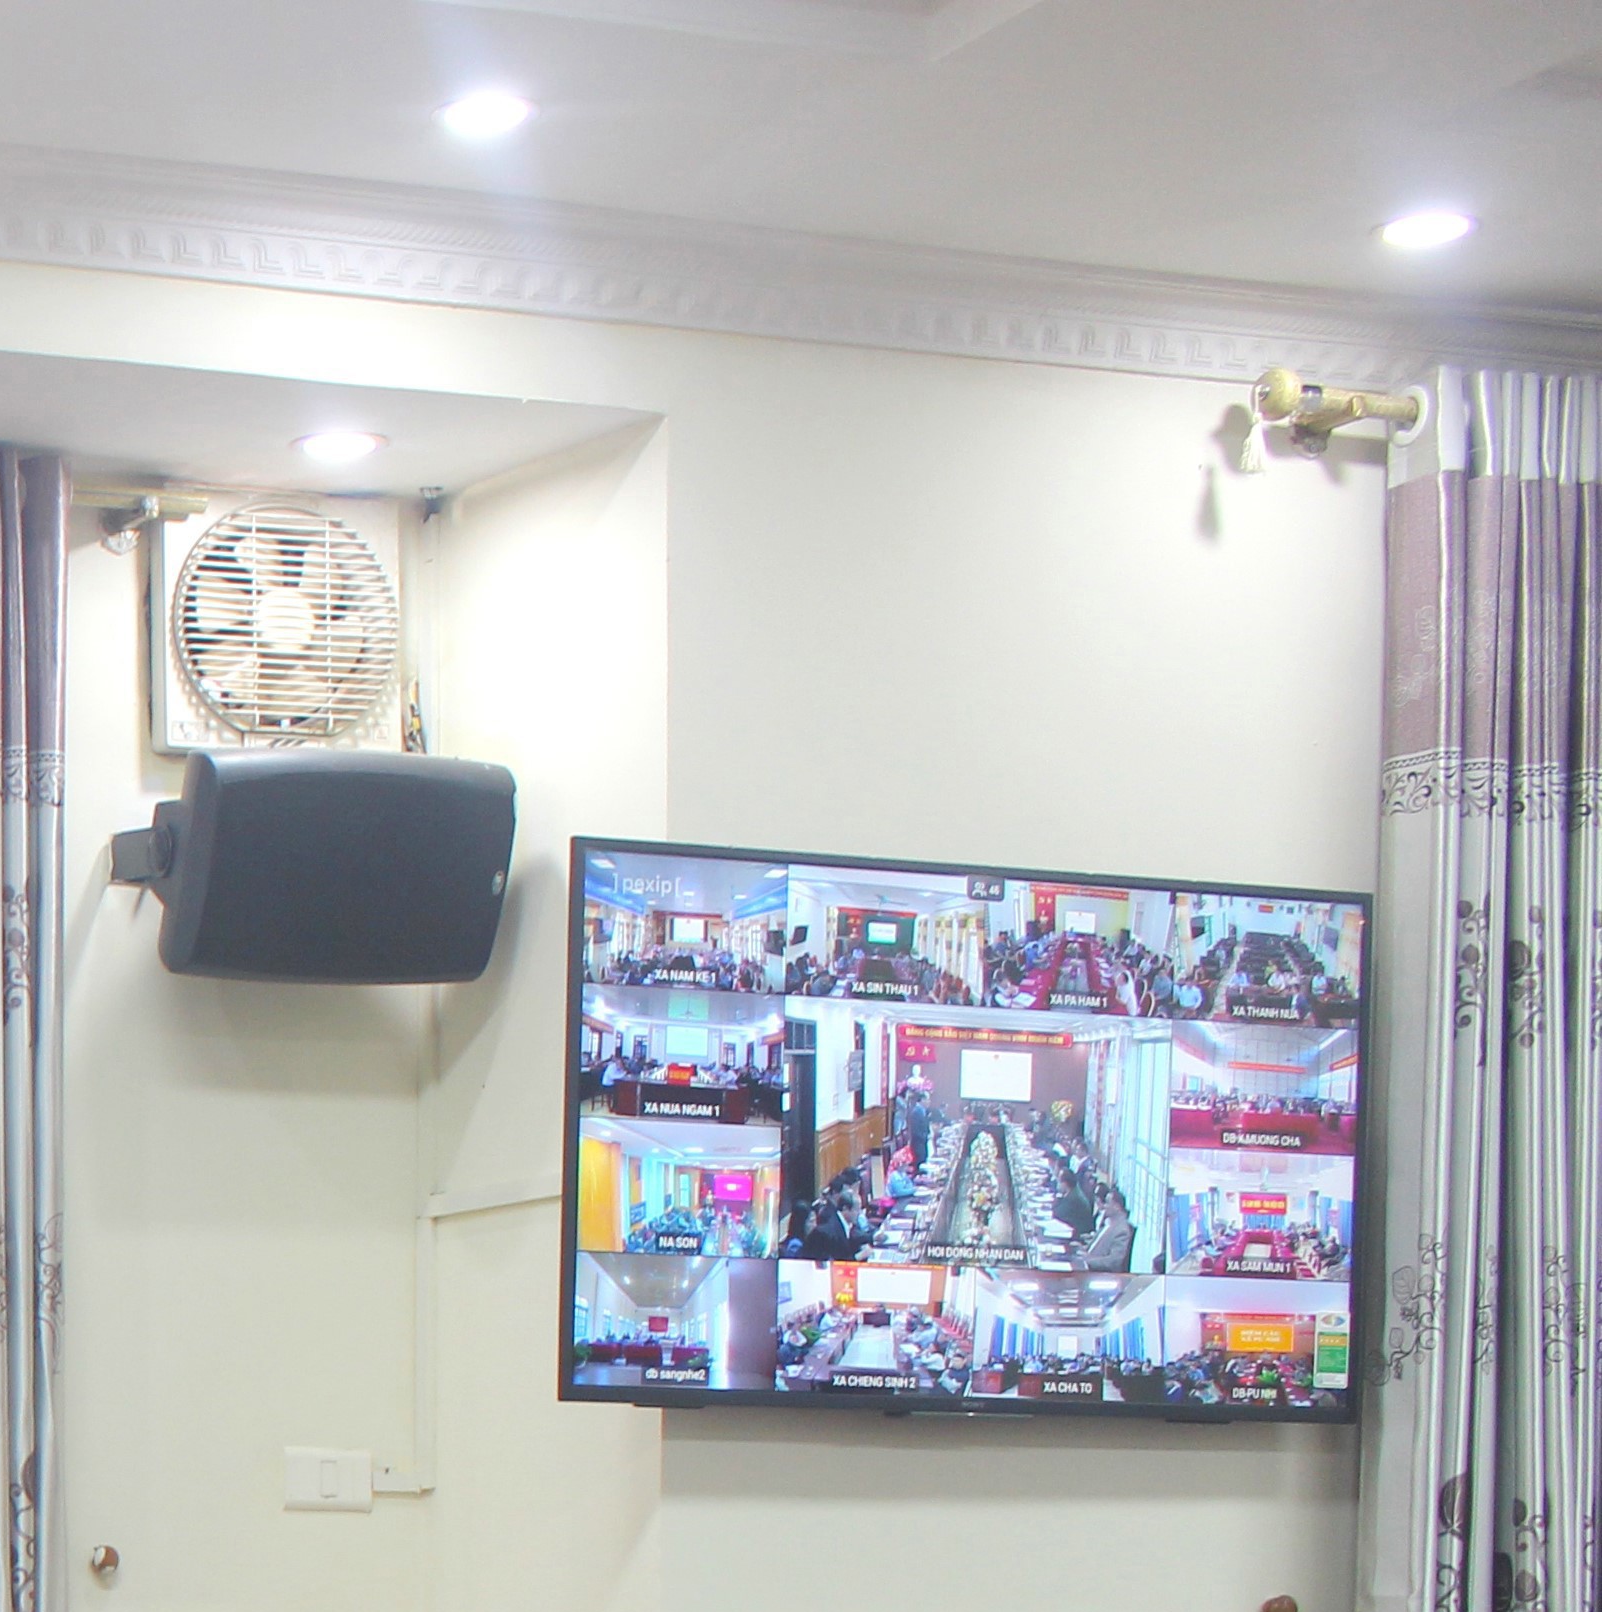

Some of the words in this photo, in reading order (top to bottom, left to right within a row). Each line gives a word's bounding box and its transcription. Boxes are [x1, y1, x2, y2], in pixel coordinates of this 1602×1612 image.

[655, 969, 668, 980] XA
[670, 970, 694, 982] NAM
[711, 971, 715, 982] 1
[852, 984, 866, 994] XA
[867, 984, 882, 994] SIN
[884, 984, 912, 995] THAU
[914, 985, 918, 995] 1
[1050, 994, 1064, 1005] XA
[1102, 997, 1107, 1008] 1
[1233, 1005, 1246, 1016] XA
[1248, 1006, 1278, 1019] THANH
[645, 1102, 658, 1114] XA
[660, 1102, 680, 1115] NUA
[682, 1104, 712, 1116] NGAM
[714, 1105, 720, 1116] 1
[658, 1236, 674, 1248] NA
[676, 1237, 697, 1249] SON
[1226, 1261, 1240, 1272] XA
[1285, 1263, 1290, 1273] 1
[833, 1375, 846, 1386] XA
[848, 1376, 882, 1388] CHIENG
[885, 1376, 908, 1388] SINH
[910, 1377, 916, 1388] 2
[1044, 1381, 1057, 1392] XA
[1058, 1382, 1078, 1393] CHA
[1080, 1382, 1092, 1393] TO
